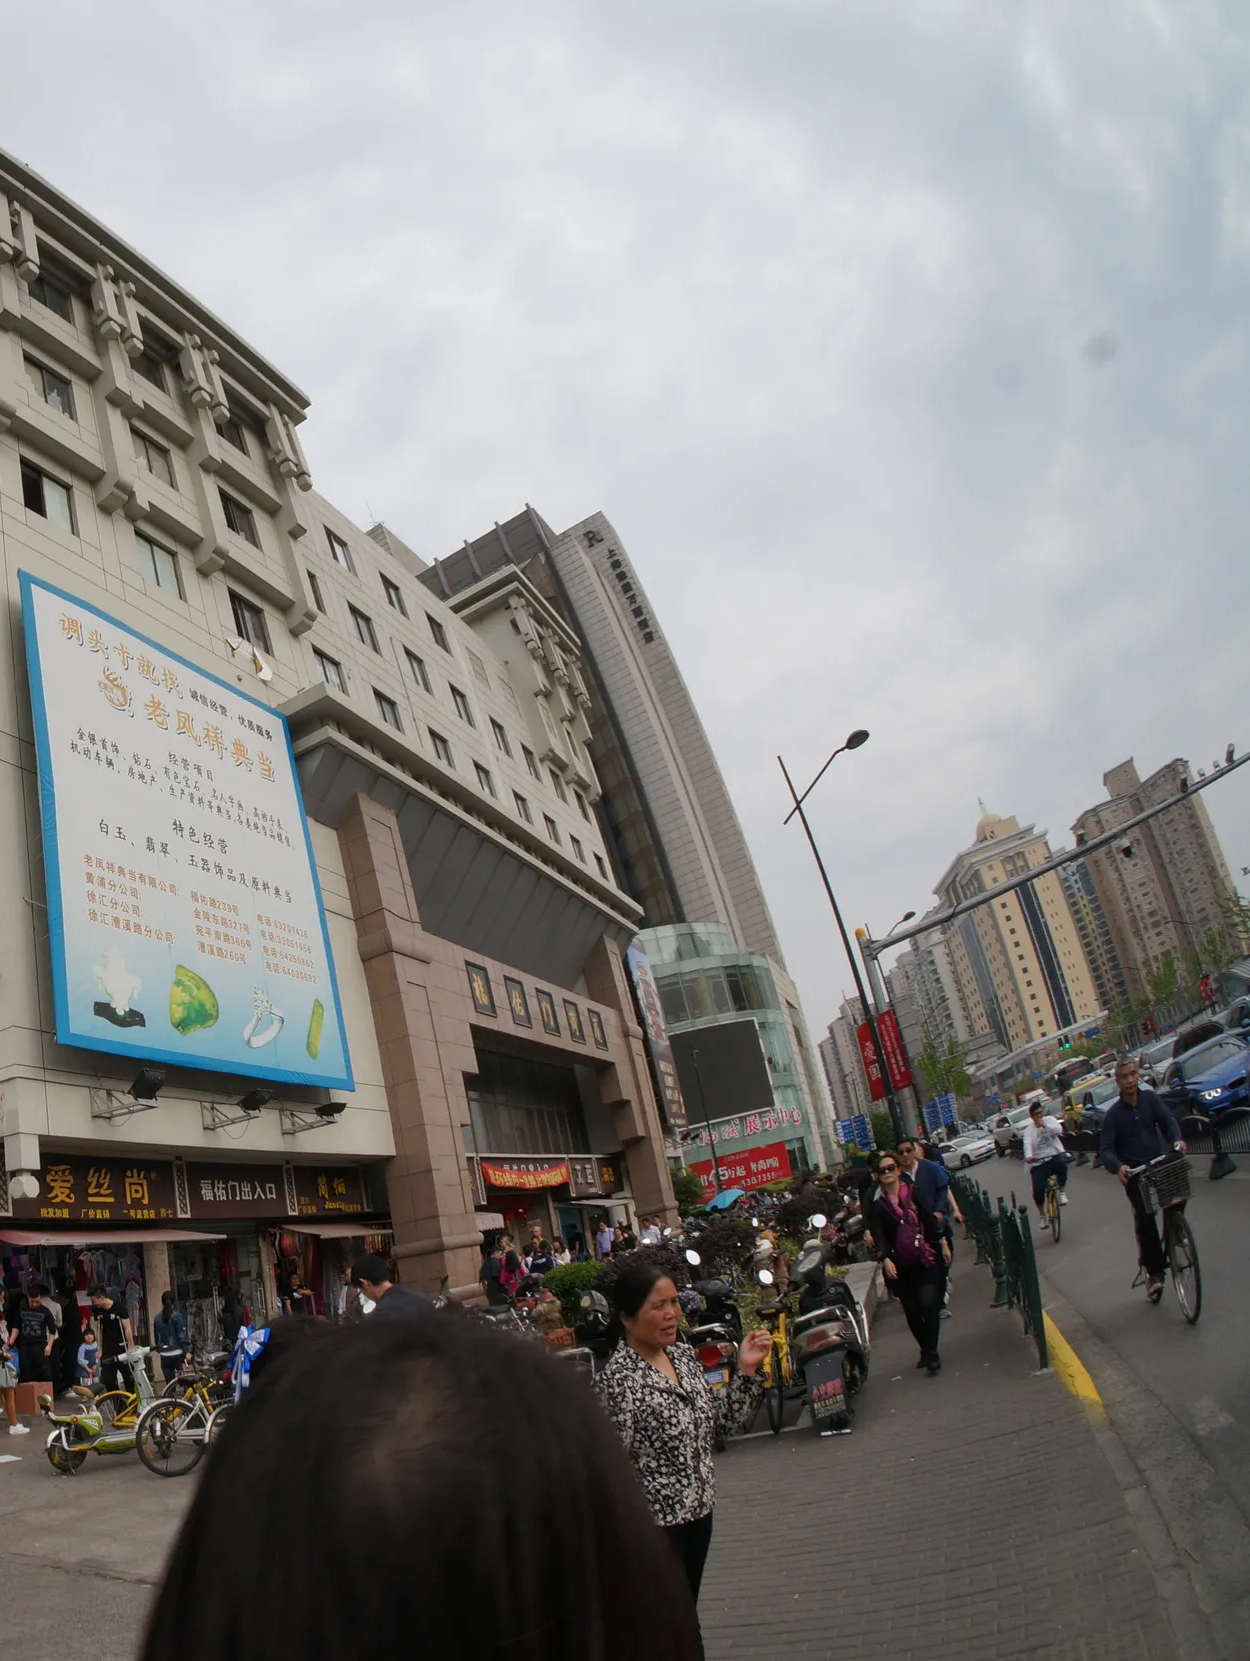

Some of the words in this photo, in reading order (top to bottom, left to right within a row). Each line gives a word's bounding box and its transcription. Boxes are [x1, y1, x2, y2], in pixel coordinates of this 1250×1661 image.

[143, 693, 276, 783] 老凤祥典当
[168, 751, 213, 781] 经营项目
[172, 818, 228, 854] 特色经营
[864, 1041, 881, 1081] 爱国
[46, 1164, 149, 1205] 爱丝尚
[200, 1179, 277, 1201] 福佑门出入口
